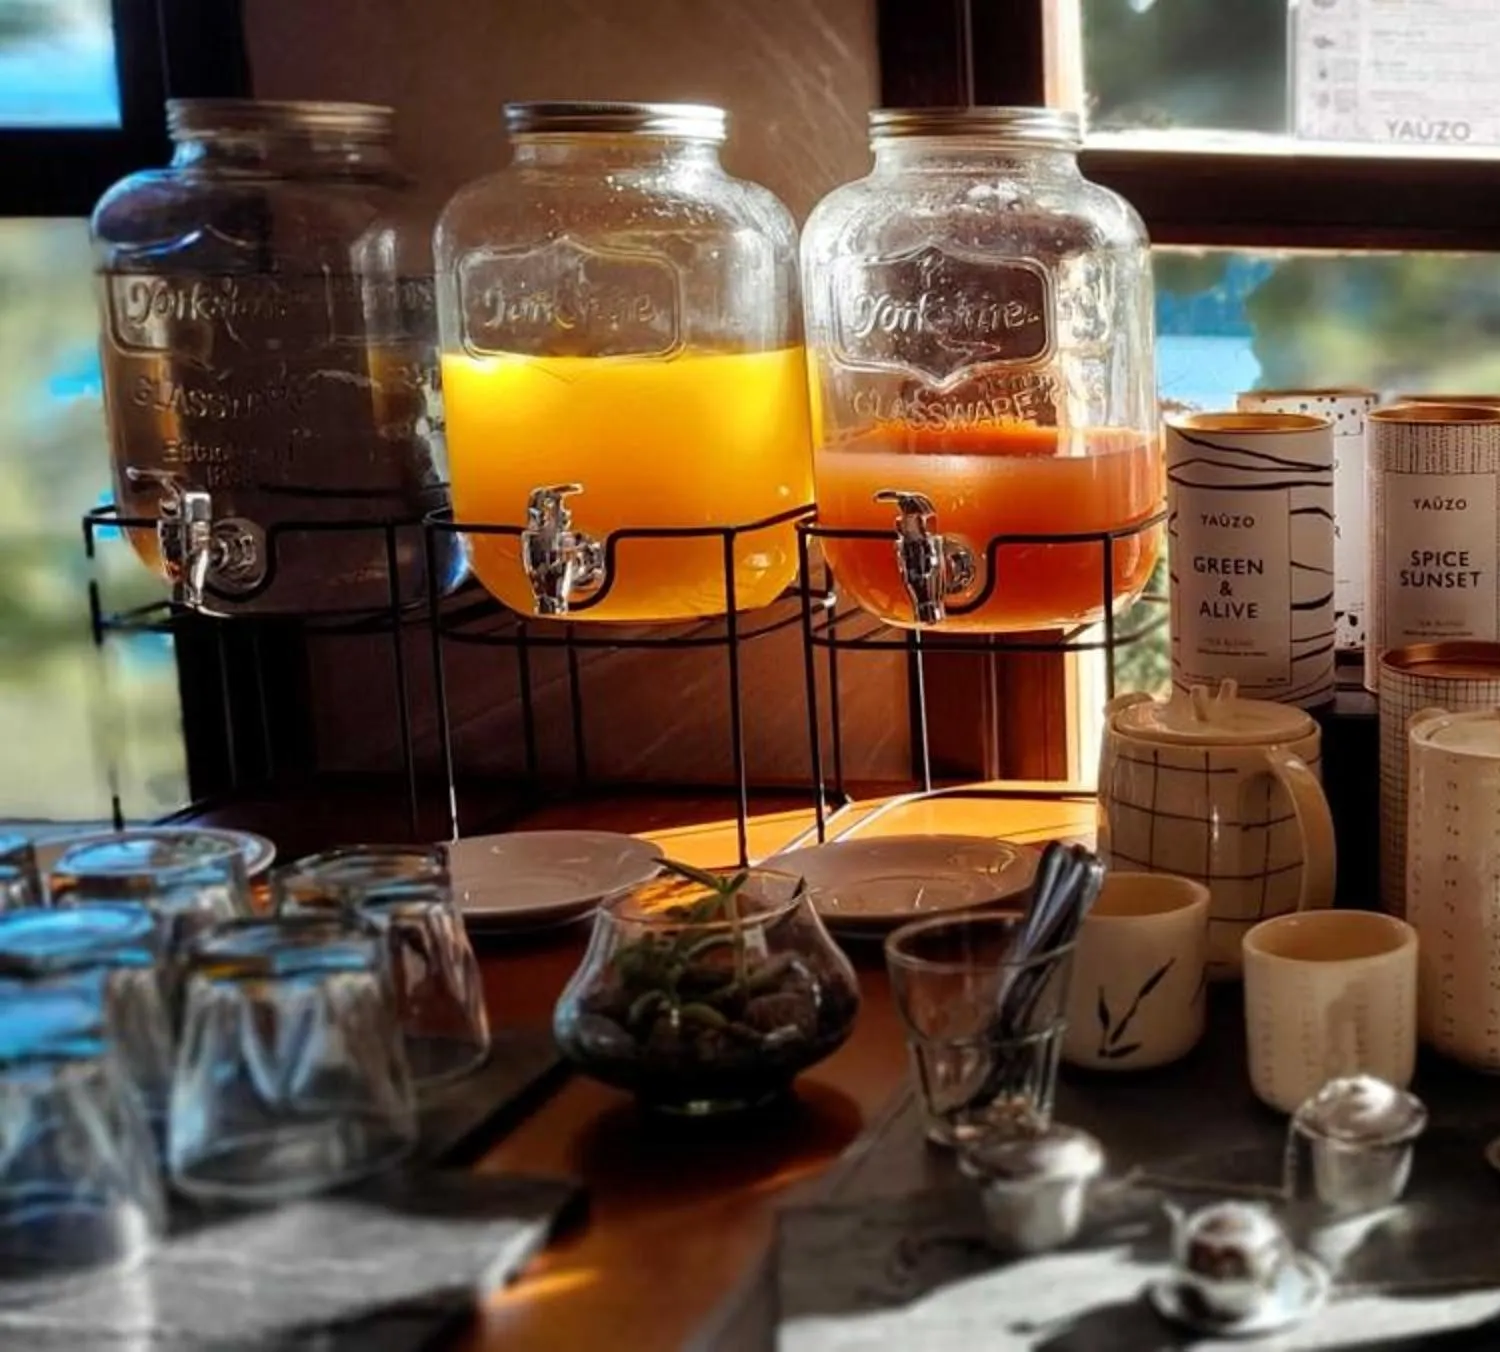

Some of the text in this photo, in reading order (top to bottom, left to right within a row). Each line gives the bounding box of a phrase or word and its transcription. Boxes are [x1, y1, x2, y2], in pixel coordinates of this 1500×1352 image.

[125, 278, 288, 324] Yorksh
[852, 388, 1038, 433] GLASSWARE
[1193, 556, 1264, 575] GREEN
[1410, 550, 1470, 568] SPICE
[1400, 569, 1482, 588] SUNSET
[1219, 580, 1233, 597] &
[1200, 601, 1259, 619] ALIVE
